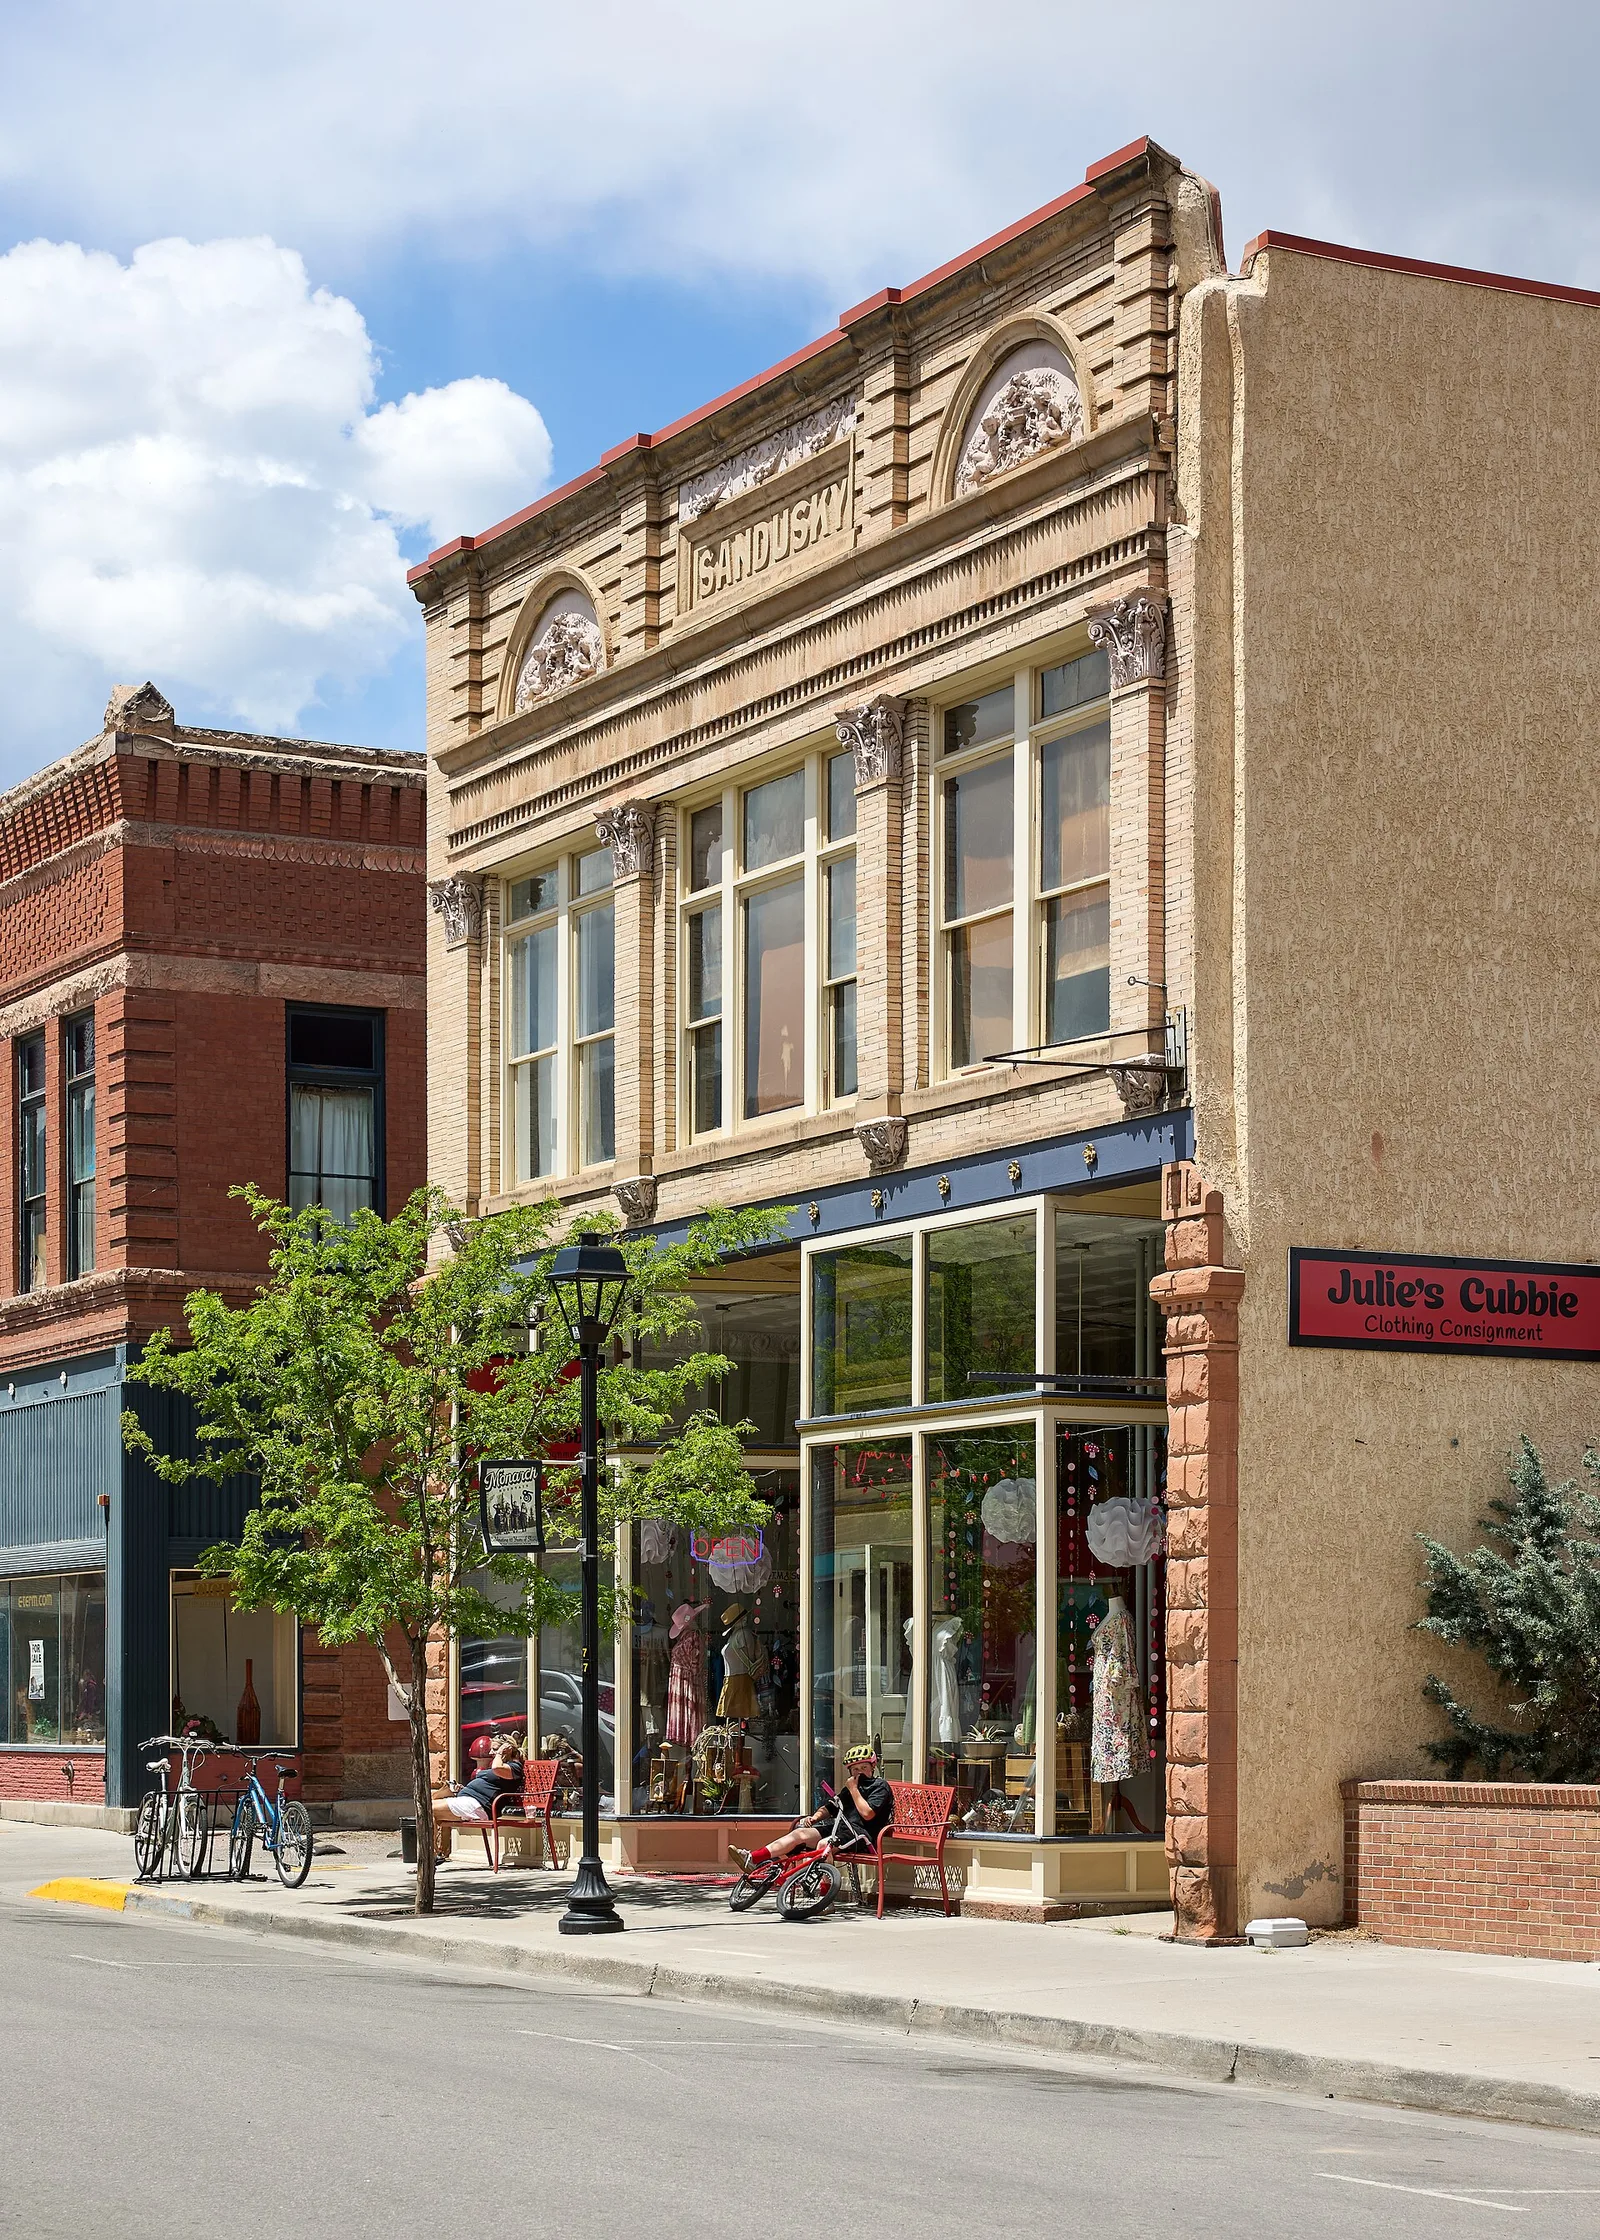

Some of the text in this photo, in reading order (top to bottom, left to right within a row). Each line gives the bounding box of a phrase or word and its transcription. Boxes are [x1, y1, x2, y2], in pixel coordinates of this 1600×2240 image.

[698, 477, 849, 597] SANDUSKY
[1327, 1268, 1580, 1319] Julie's Cubbie
[1364, 1314, 1544, 1342] Clothing Consignment
[484, 1467, 539, 1491] Monarch
[693, 1537, 759, 1558] OPEN
[32, 1643, 41, 1653] FOR
